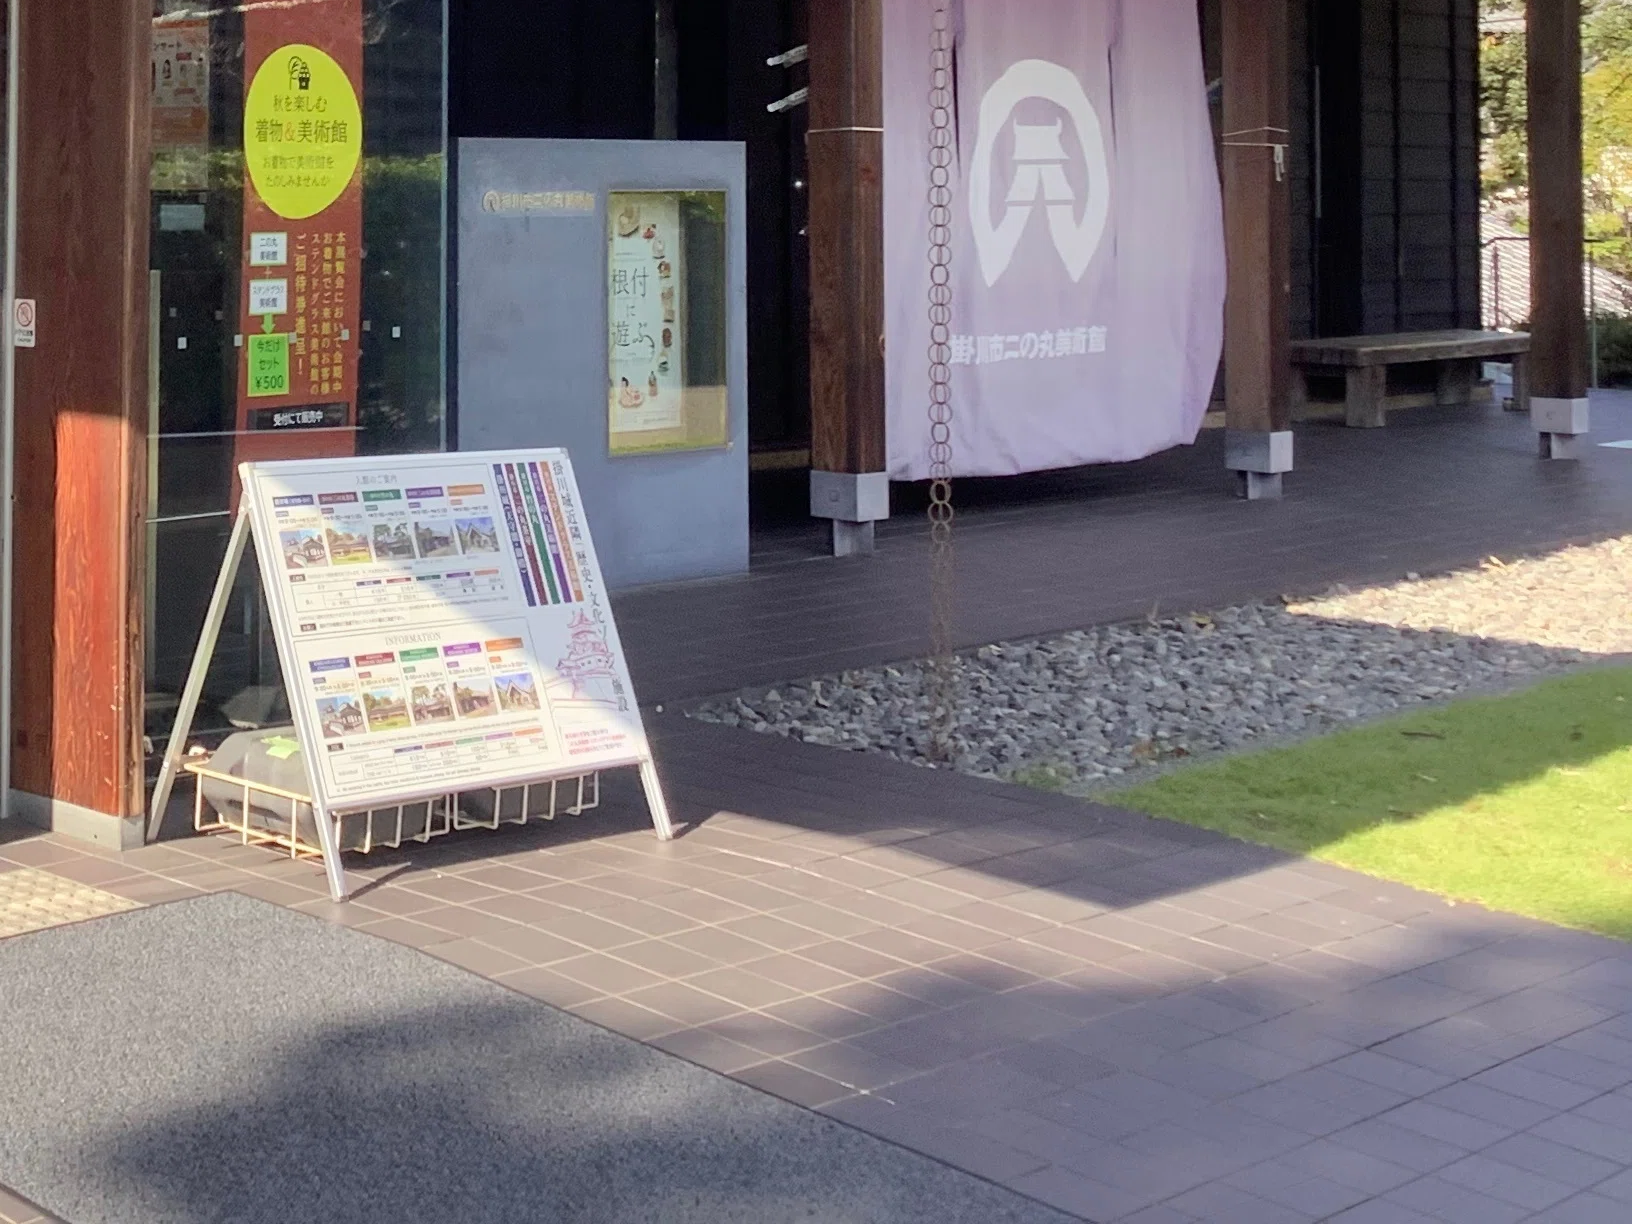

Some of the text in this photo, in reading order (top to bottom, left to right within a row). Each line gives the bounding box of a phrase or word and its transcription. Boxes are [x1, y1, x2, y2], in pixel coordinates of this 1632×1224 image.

[273, 95, 328, 113] 秋を楽しむ
[256, 118, 348, 144] 着物&美術館
